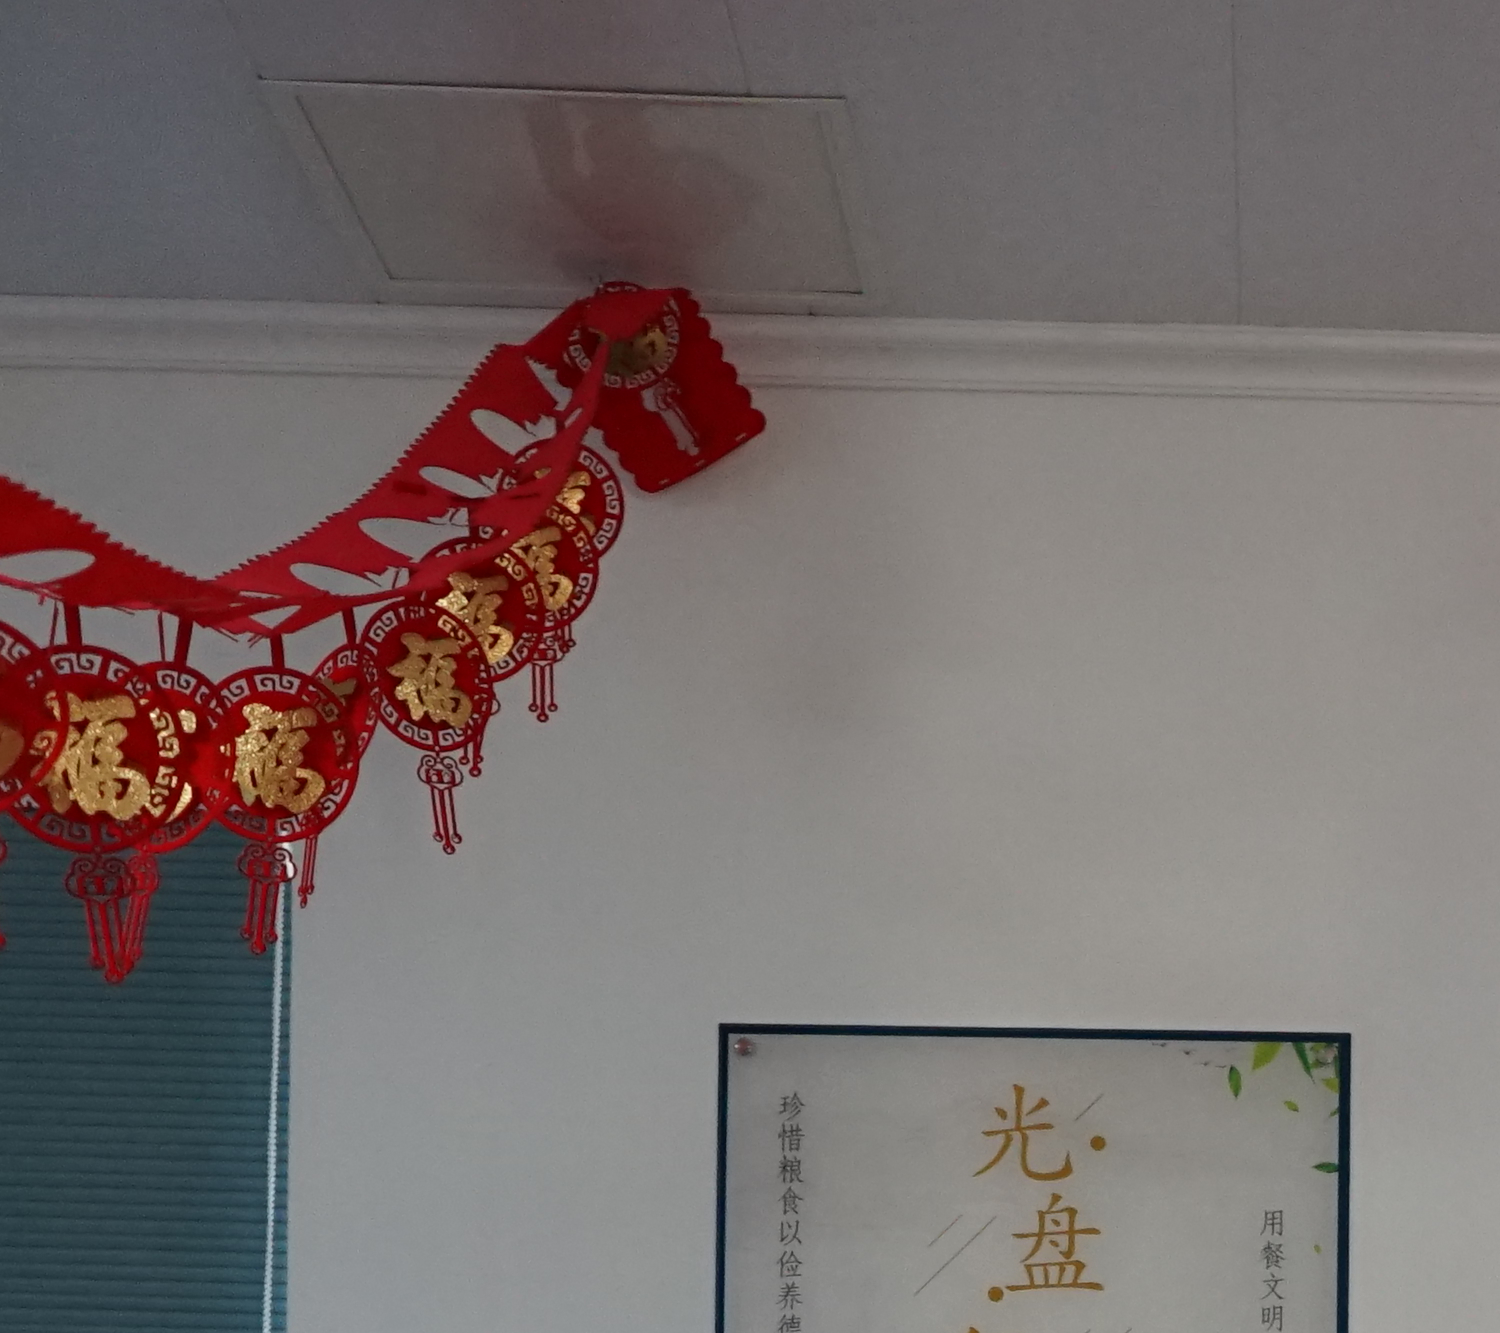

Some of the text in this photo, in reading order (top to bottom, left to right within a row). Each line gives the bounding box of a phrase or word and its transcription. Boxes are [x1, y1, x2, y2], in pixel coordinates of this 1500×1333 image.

[386, 631, 473, 730] 福
[35, 689, 153, 821] 福
[233, 702, 326, 813] 福
[1260, 1209, 1286, 1332] 用餐文明
